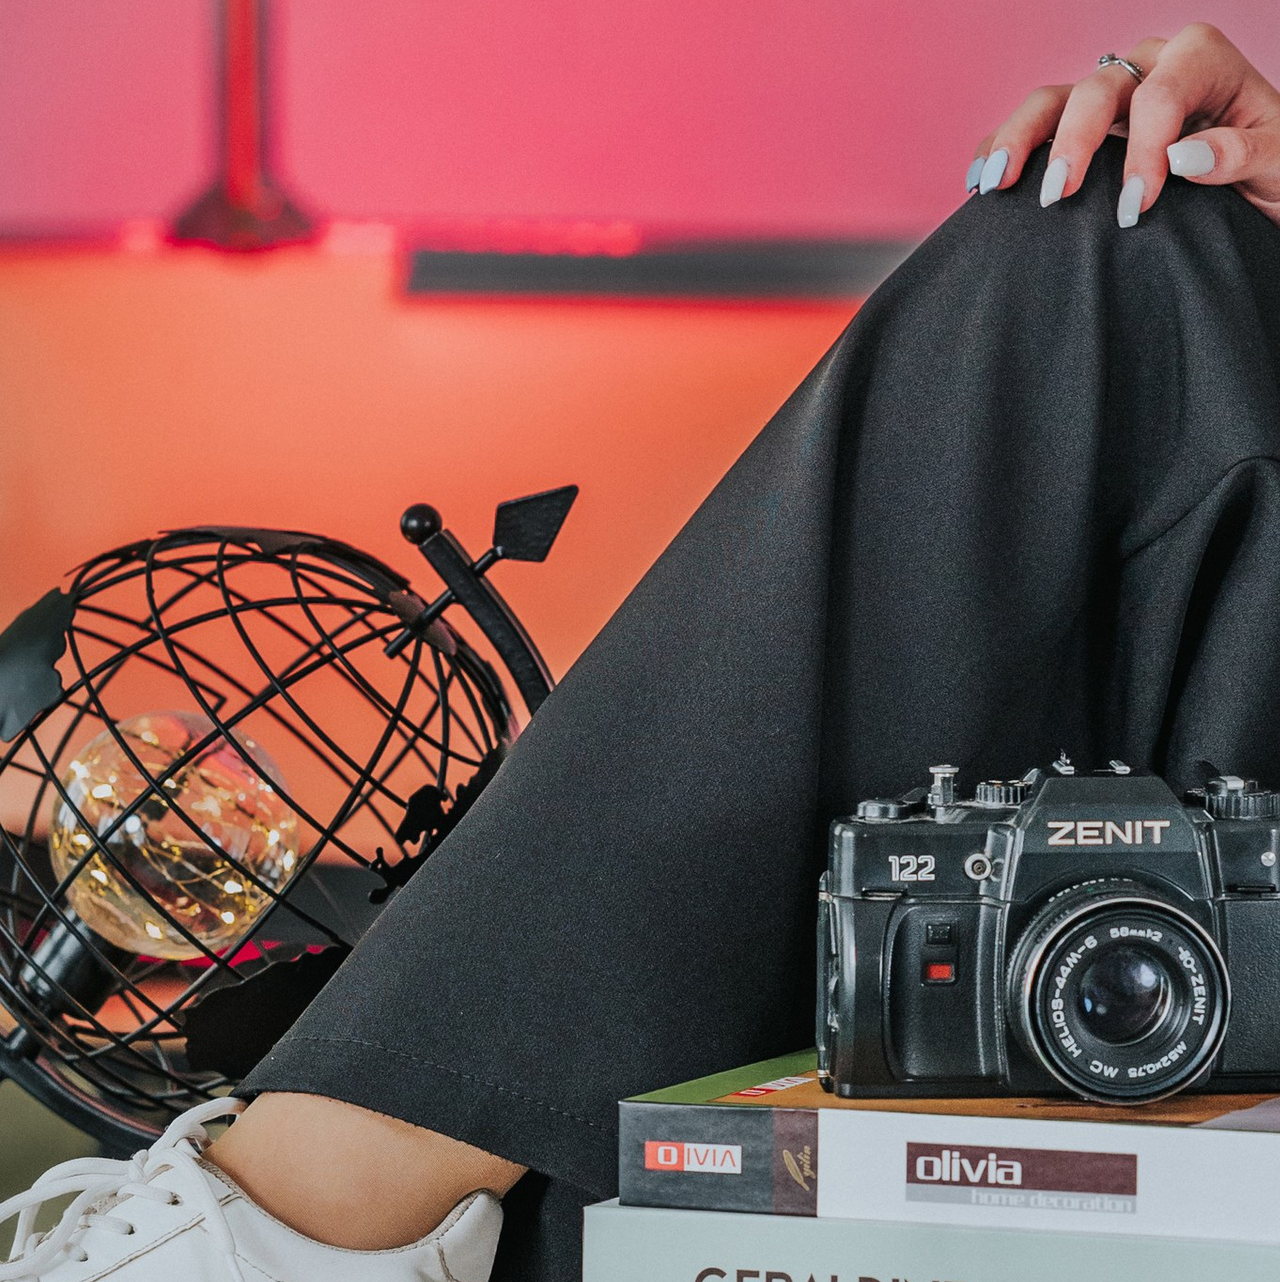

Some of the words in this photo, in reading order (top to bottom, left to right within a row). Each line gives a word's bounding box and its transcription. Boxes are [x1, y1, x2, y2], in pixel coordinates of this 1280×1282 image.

[1047, 820, 1171, 846] ZENIT
[888, 854, 936, 882] 122
[1089, 1060, 1119, 1078] MC
[916, 1149, 1022, 1185] olivia
[971, 1189, 1026, 1207] home
[1029, 1193, 1133, 1213] decoration
